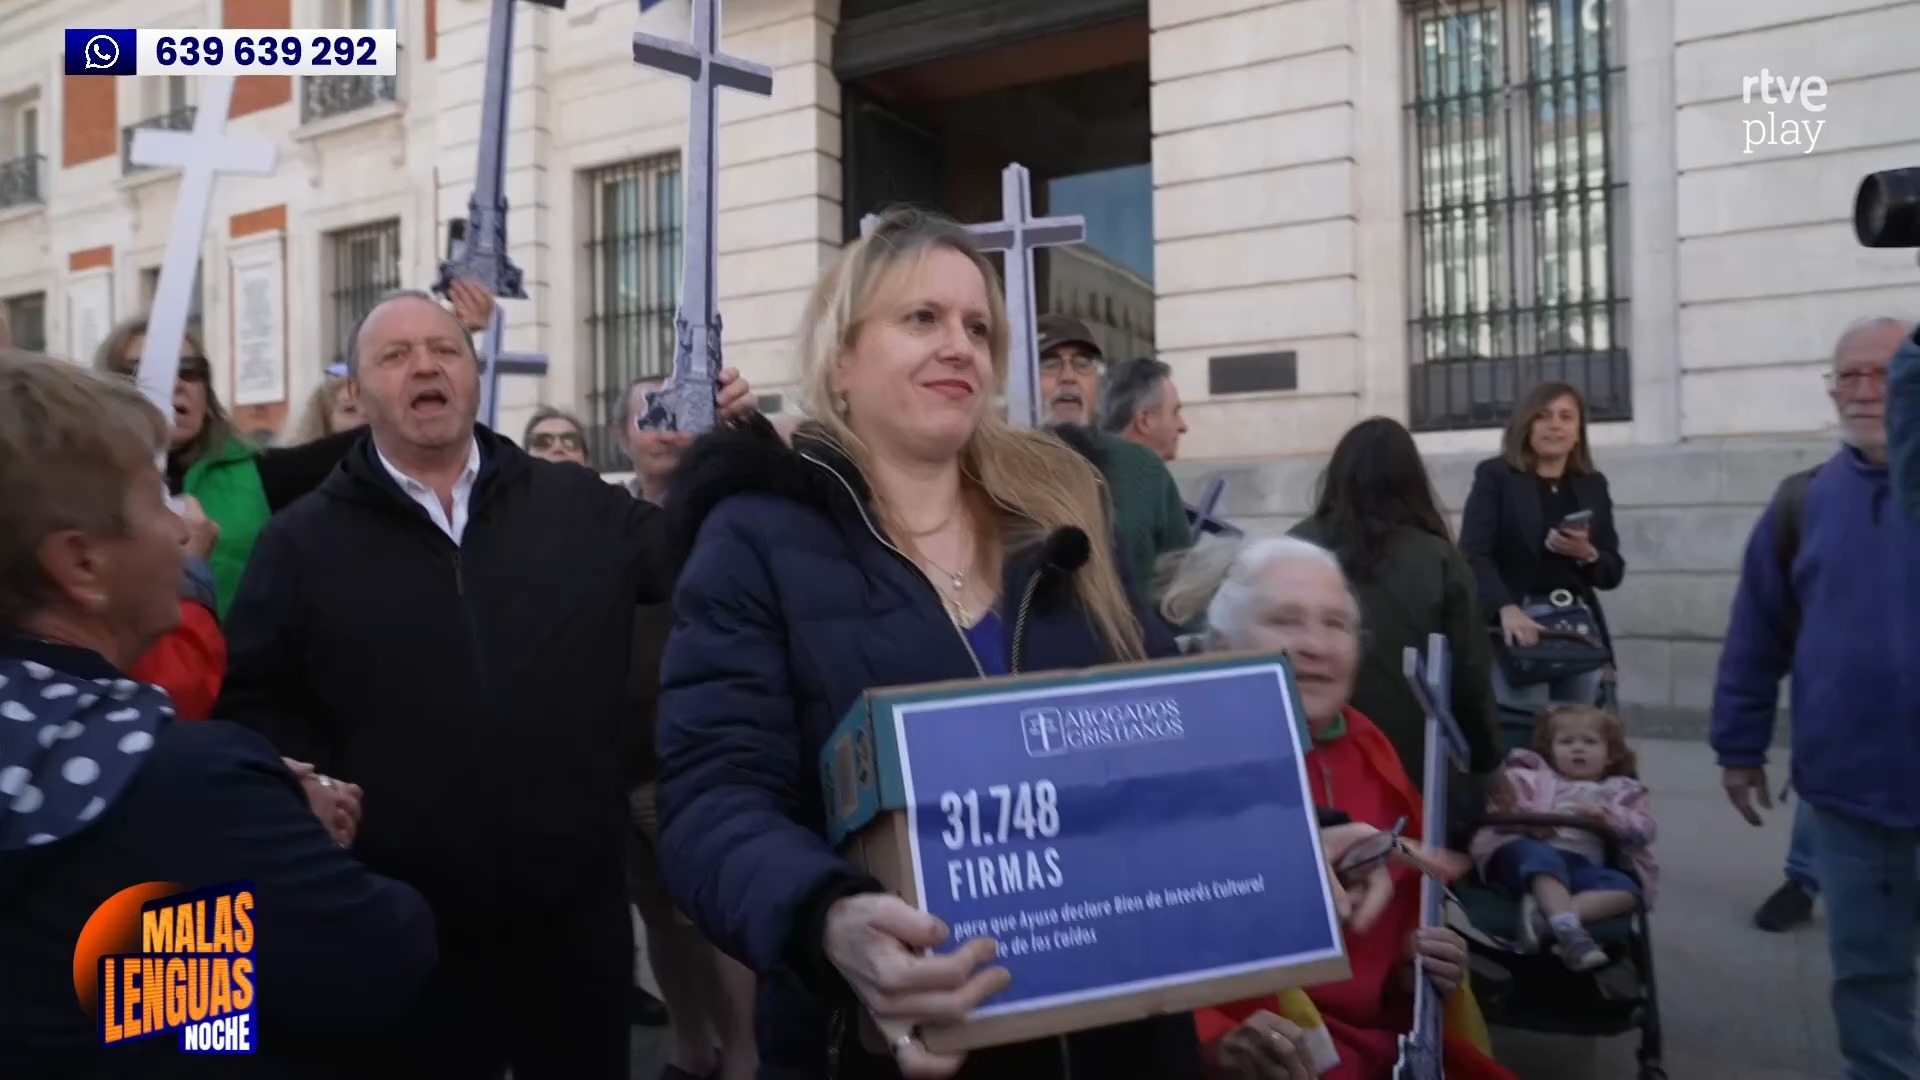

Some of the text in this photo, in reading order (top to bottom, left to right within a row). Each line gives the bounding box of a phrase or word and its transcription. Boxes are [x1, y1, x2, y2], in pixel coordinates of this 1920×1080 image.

[1065, 698, 1180, 729] ABOGADOS
[1067, 717, 1184, 748] CRISTIANOS
[940, 778, 1060, 850] 31.748
[947, 846, 1064, 902] FIRMAS
[954, 919, 988, 943] para
[990, 914, 1017, 938] que
[1019, 908, 1059, 934] Ayuso
[1060, 900, 1112, 923] declare
[1113, 894, 1145, 915] Bien
[1145, 889, 1163, 910] de
[1212, 872, 1265, 899] Cultural
[1011, 935, 1029, 956] de
[1031, 930, 1052, 952] los
